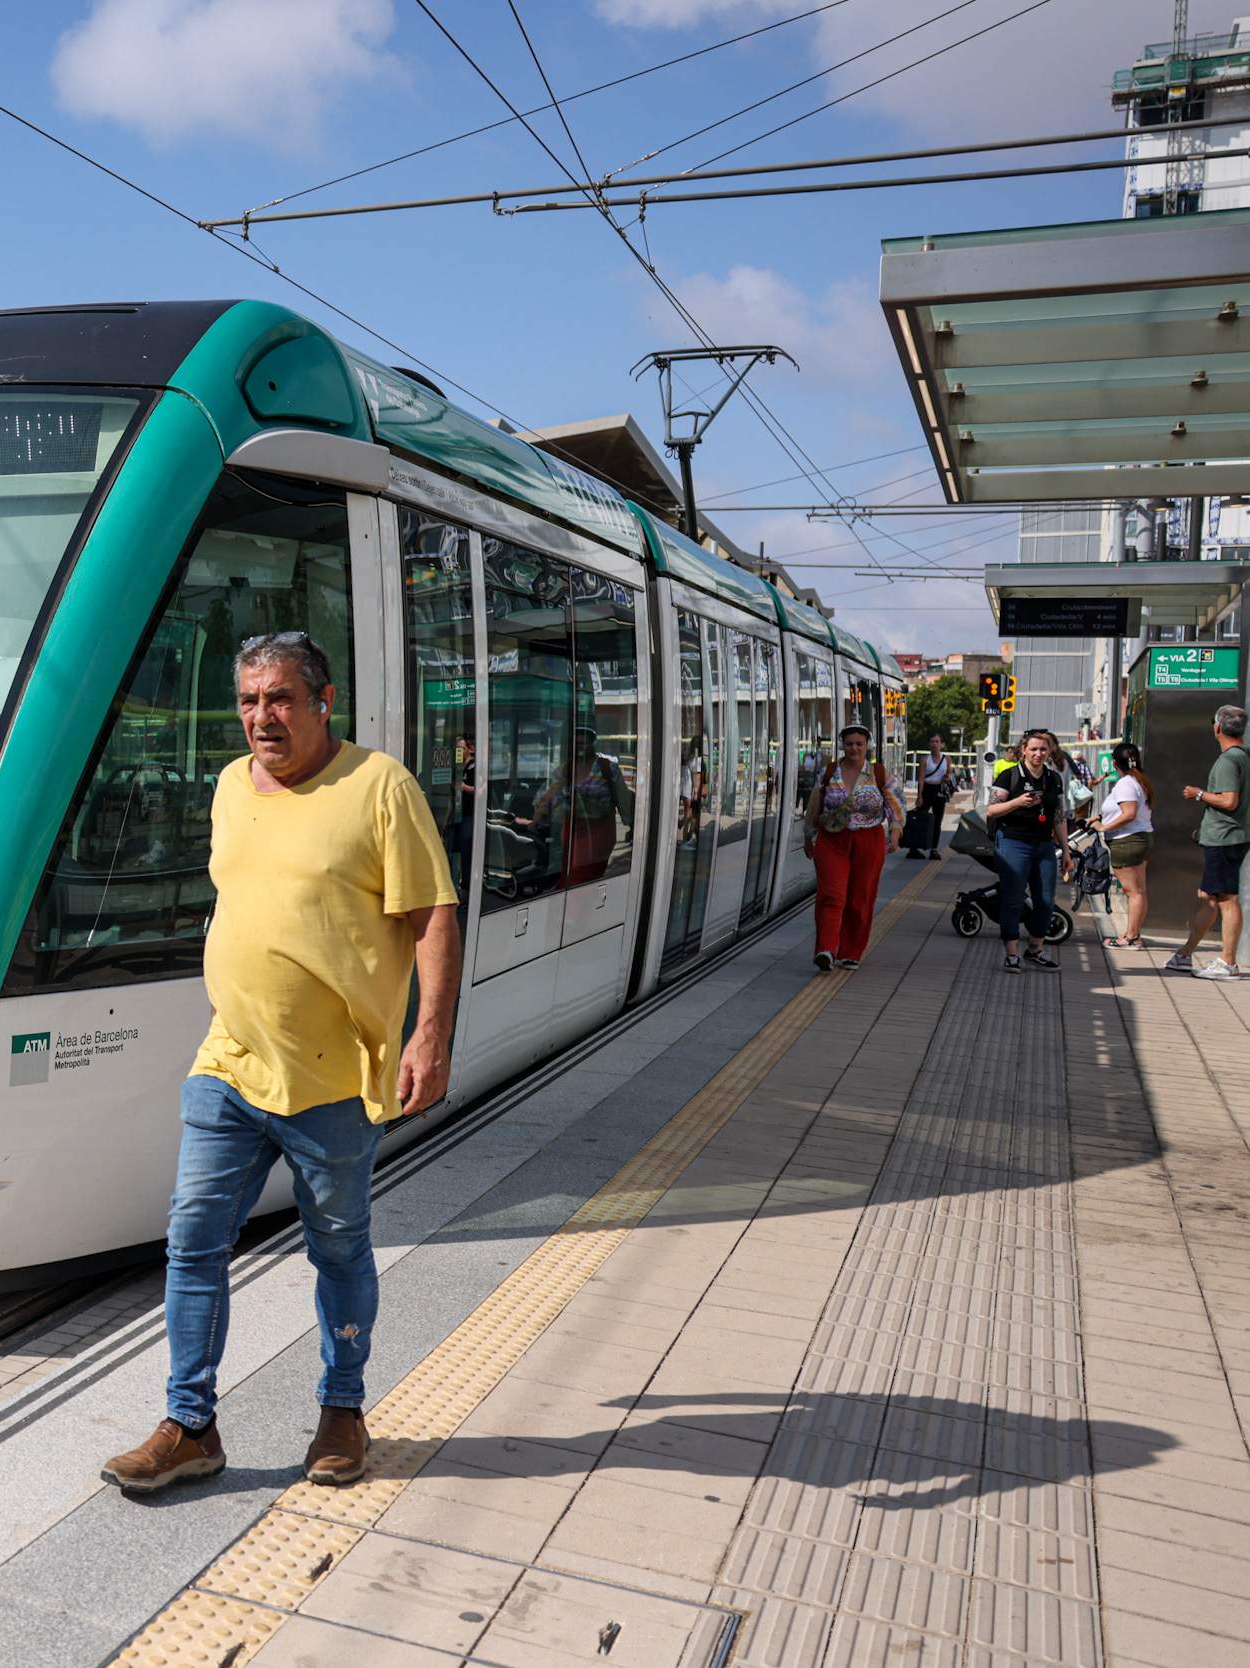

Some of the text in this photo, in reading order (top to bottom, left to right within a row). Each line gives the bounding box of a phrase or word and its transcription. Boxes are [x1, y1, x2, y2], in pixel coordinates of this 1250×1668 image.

[1186, 649, 1197, 662] 2
[56, 1027, 139, 1048] Àrea de Barcelona
[23, 1039, 47, 1053] ATM
[55, 1043, 124, 1060] Autoritat del Transport
[55, 1058, 90, 1070] Metropolità
